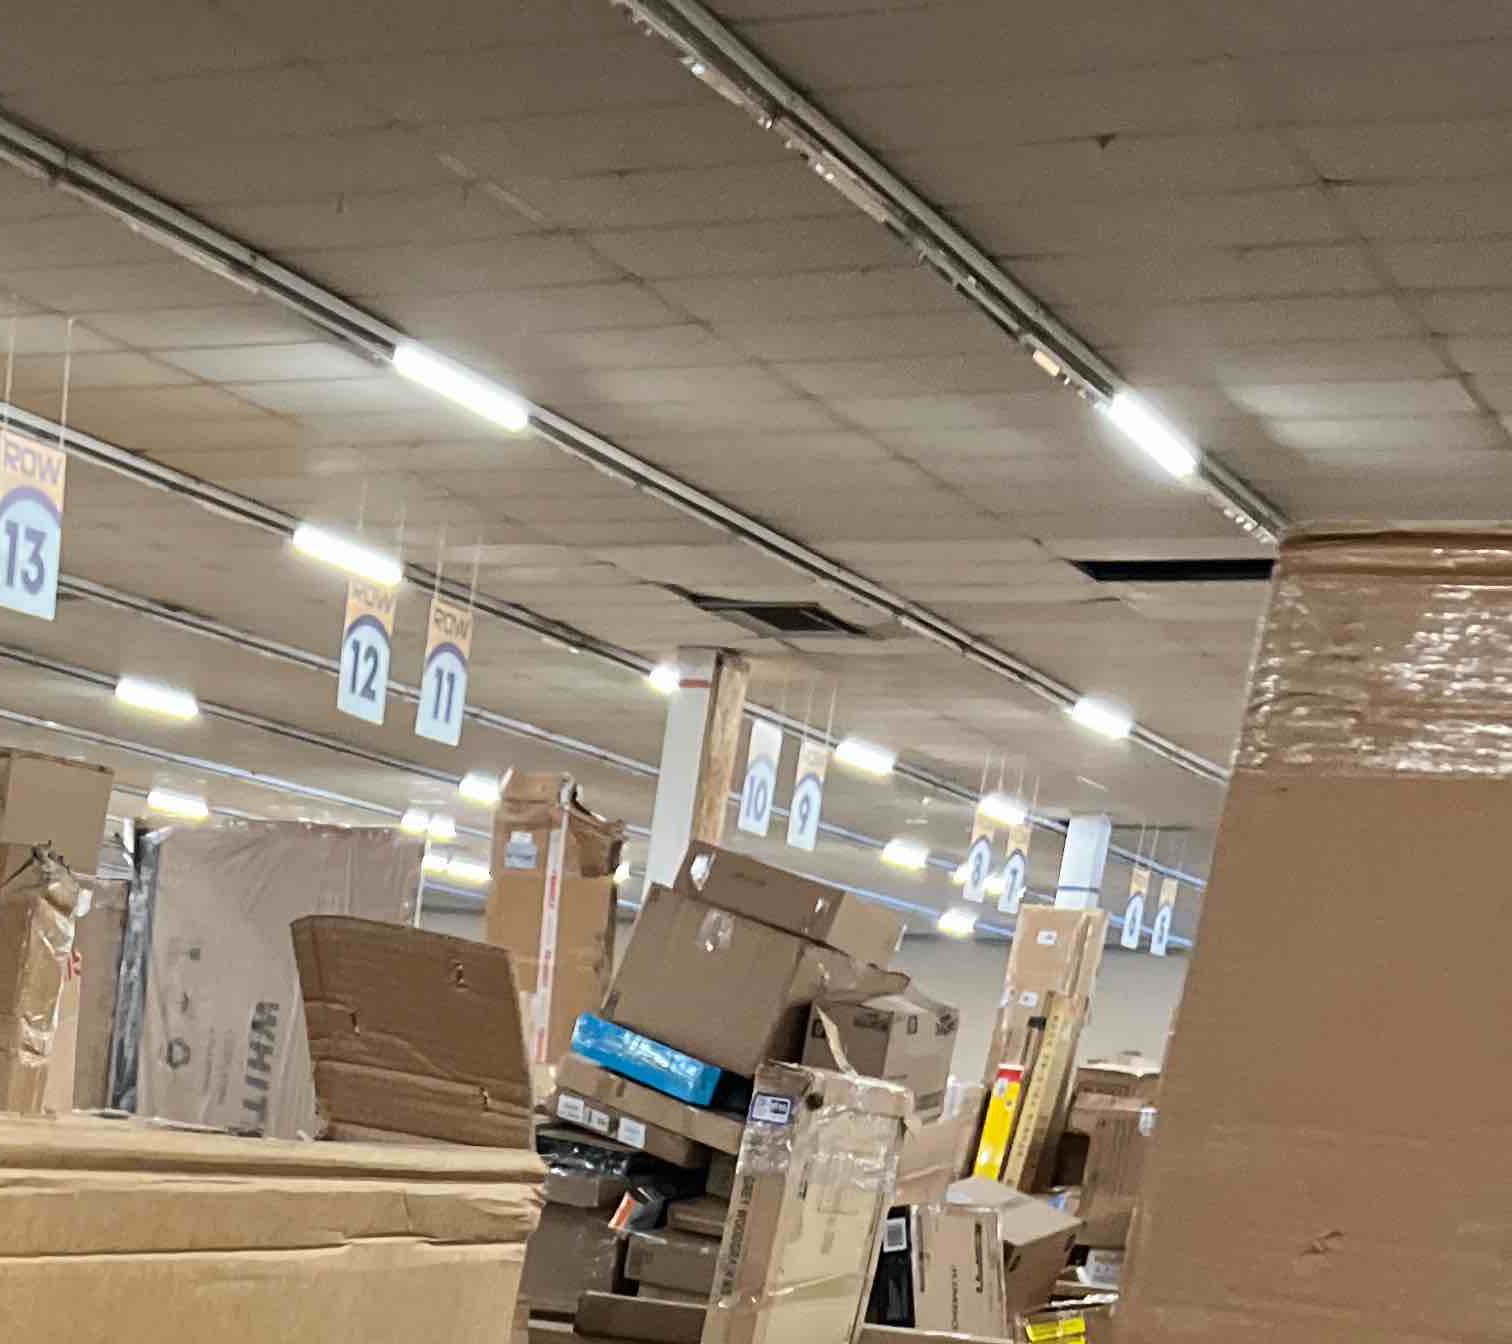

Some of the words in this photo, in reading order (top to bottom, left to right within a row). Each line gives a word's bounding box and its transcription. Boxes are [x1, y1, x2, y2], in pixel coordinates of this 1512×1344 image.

[3, 436, 63, 484] ROW
[4, 519, 47, 596] 13
[432, 609, 469, 640] ROW
[349, 638, 377, 701] 12
[433, 667, 456, 725] 11
[744, 774, 768, 823] 10
[798, 799, 811, 833] 9
